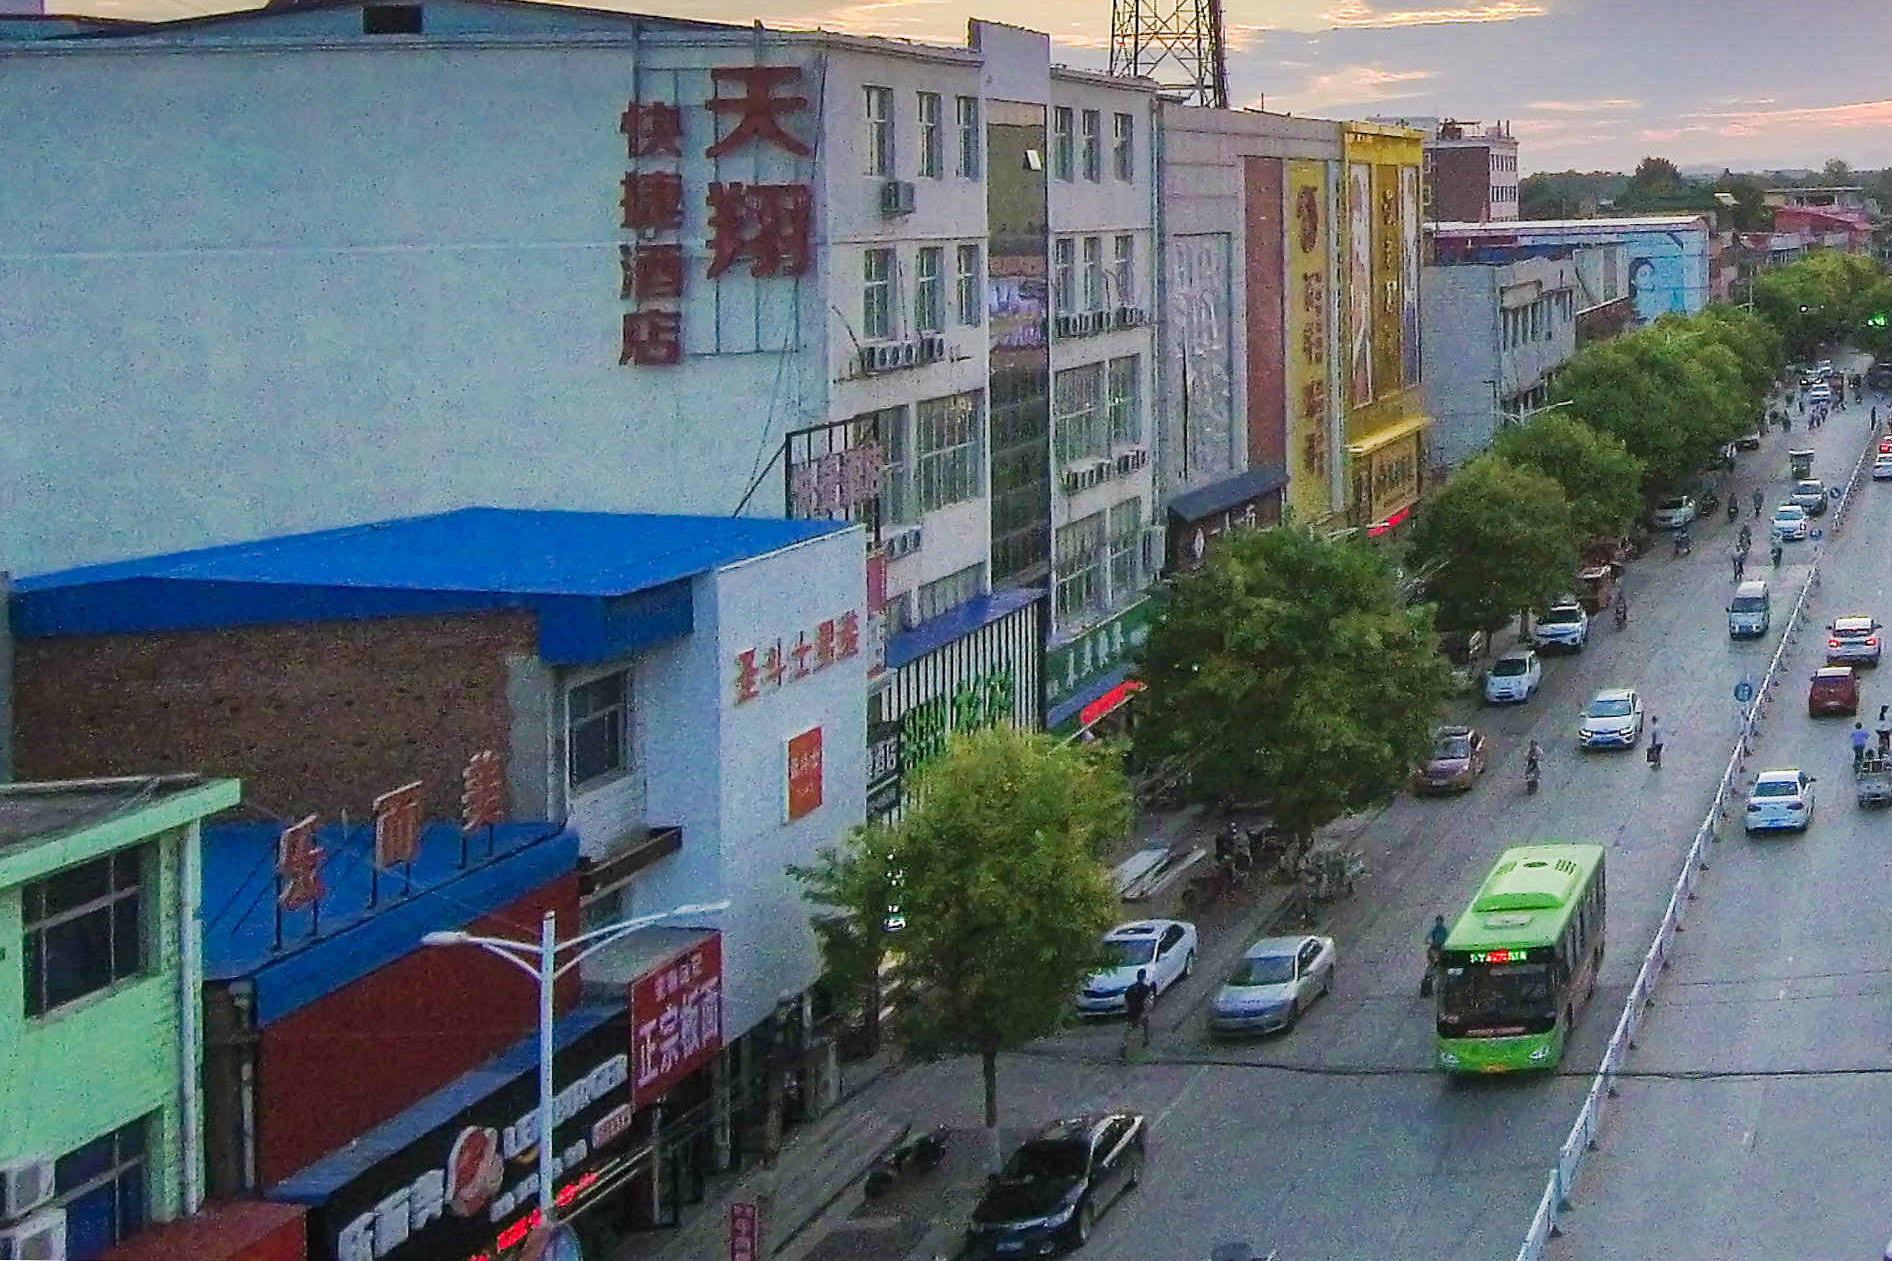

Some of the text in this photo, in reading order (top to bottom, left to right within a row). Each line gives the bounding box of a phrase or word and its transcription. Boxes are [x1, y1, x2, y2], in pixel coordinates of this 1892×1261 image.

[619, 100, 685, 367] 快捷酒店
[704, 65, 814, 280] 天翔
